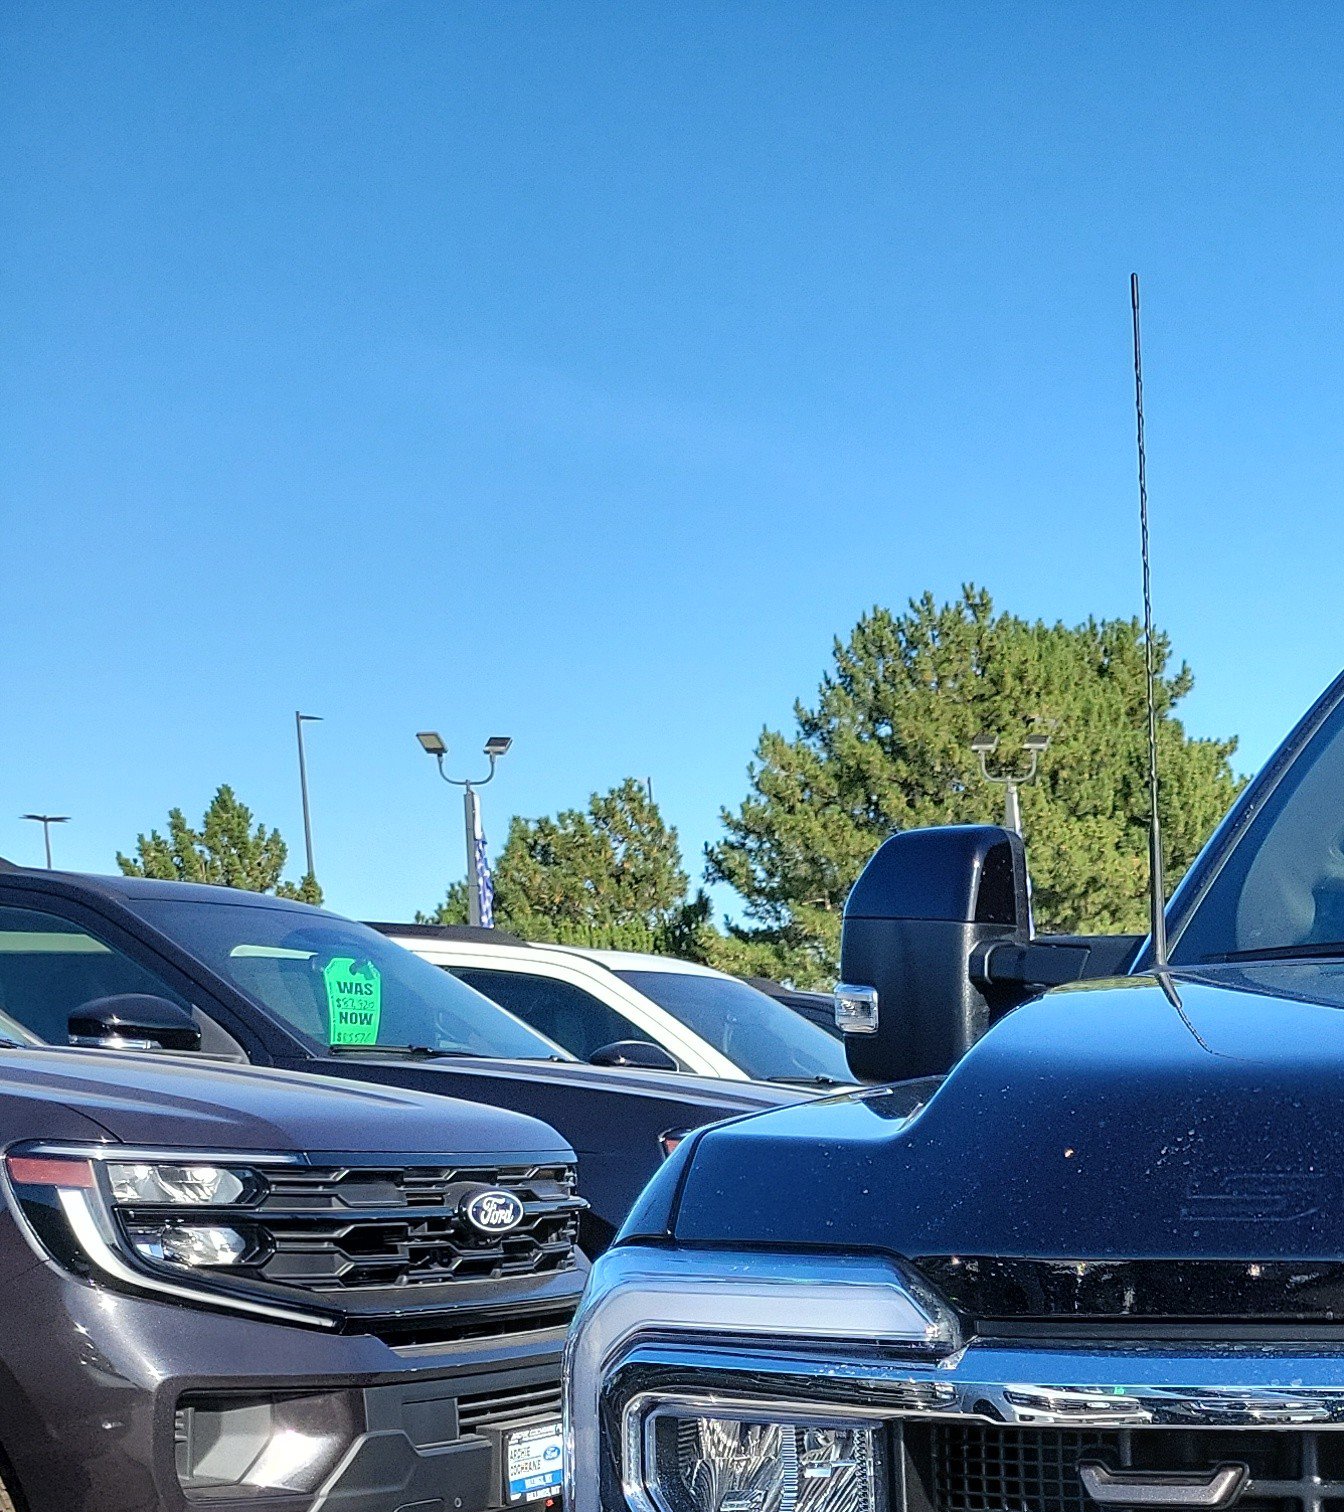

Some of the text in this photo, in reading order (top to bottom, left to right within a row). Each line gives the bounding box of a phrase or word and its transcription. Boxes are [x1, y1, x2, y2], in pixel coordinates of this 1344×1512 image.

[336, 981, 373, 995] WAS
[339, 1012, 373, 1025] NOW
[480, 1197, 514, 1225] Ford
